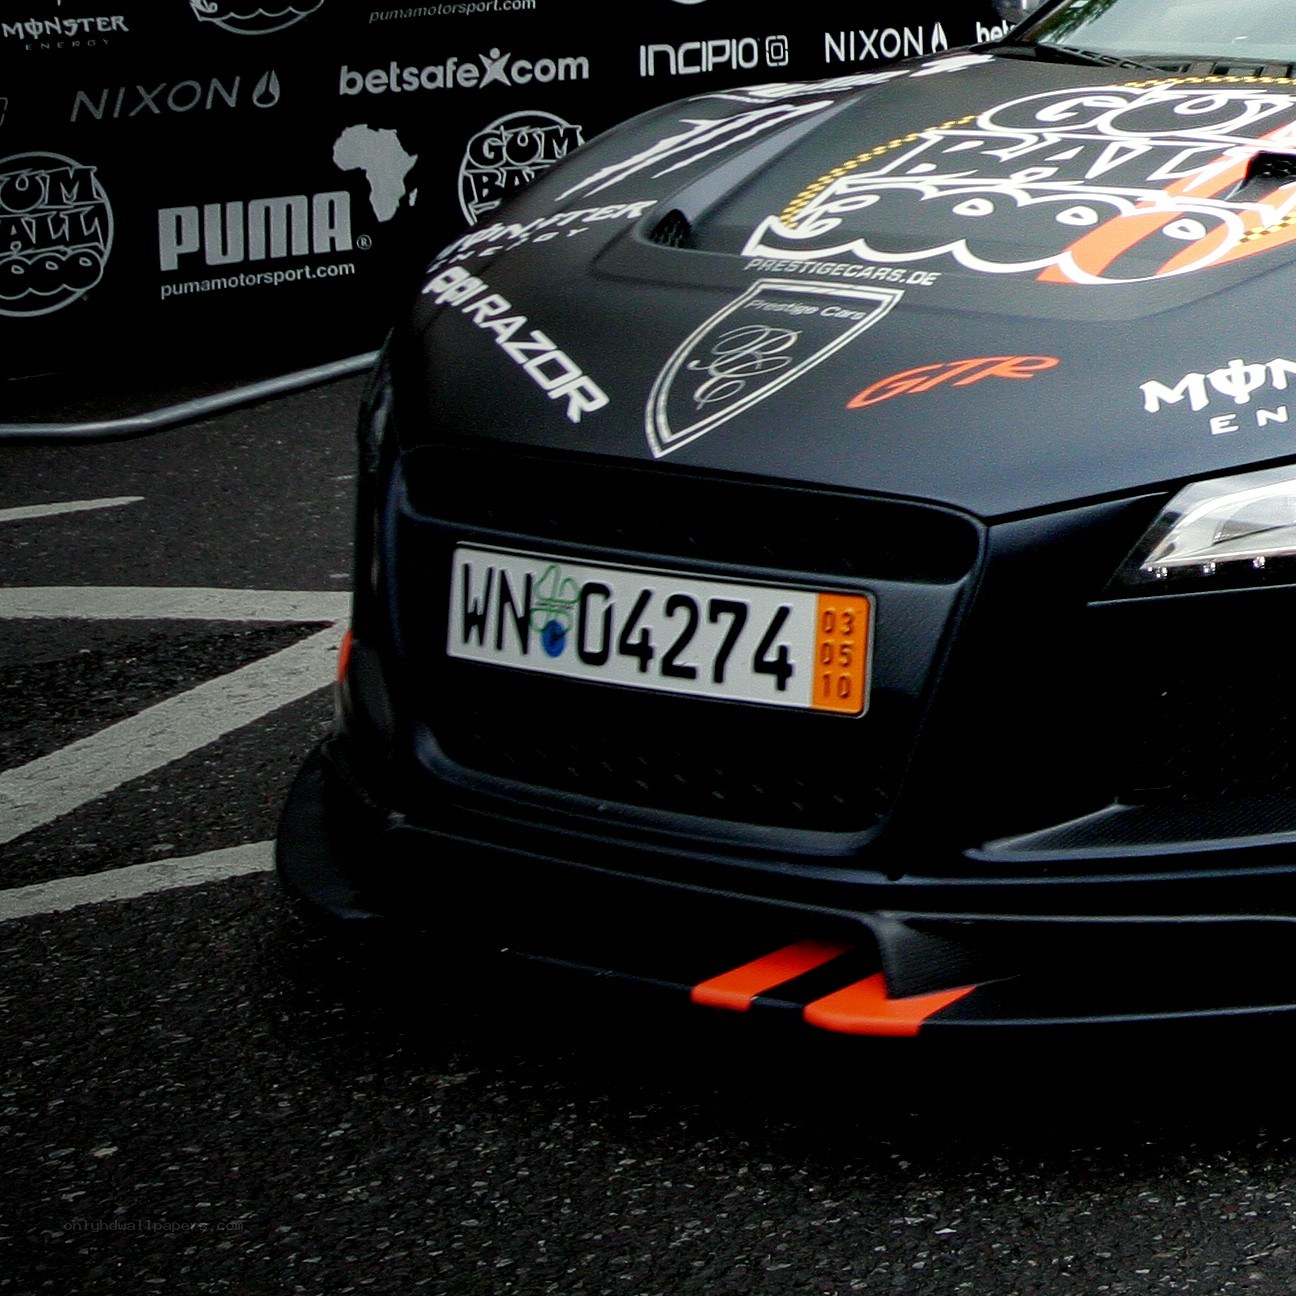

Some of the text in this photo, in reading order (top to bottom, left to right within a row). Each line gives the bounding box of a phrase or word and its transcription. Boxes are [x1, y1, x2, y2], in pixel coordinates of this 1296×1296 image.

[1, 15, 129, 41] MONSTER
[824, 25, 925, 64] NIXON
[639, 37, 758, 77] INCIPIO
[70, 76, 241, 122] NIXON
[0, 166, 105, 213] UM
[0, 206, 105, 255] ALL
[158, 190, 353, 272] PUMA
[0, 244, 103, 300] 000
[160, 262, 356, 300] pumamotorsport.com
[743, 258, 942, 287] PRESTIGECARS.DE
[746, 298, 867, 321] Prestige Cars
[461, 293, 610, 424] RAZOR
[846, 355, 1061, 410] GTR
[461, 562, 794, 692] WN 04274
